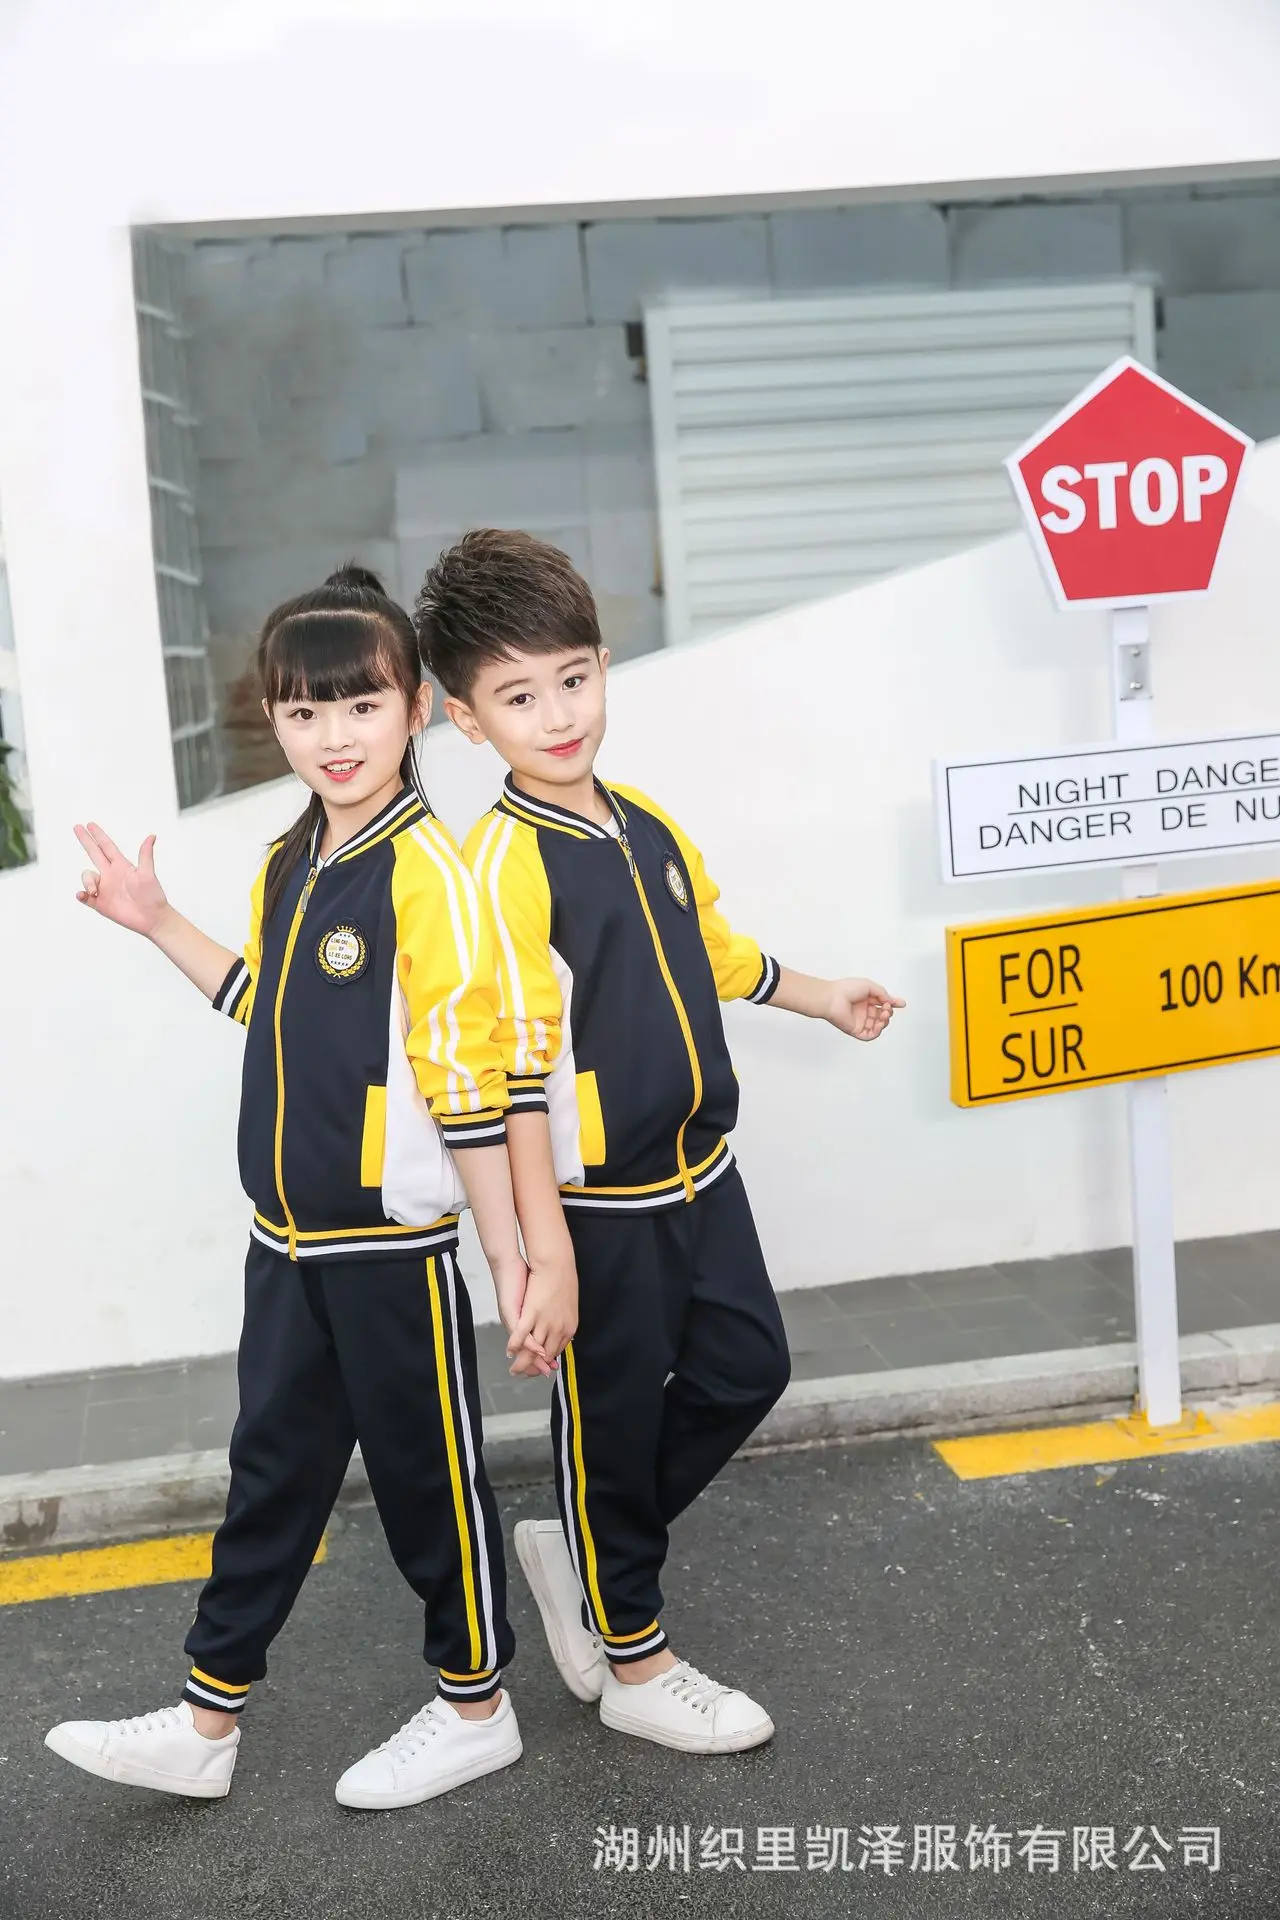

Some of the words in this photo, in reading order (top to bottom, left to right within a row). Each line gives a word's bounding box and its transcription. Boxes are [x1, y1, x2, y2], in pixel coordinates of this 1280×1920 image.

[1040, 454, 1229, 535] STOP
[1019, 773, 1129, 808] NIGHT
[1156, 757, 1280, 793] DANGE
[979, 811, 1132, 850] DANGER
[1161, 803, 1207, 831] DE
[1236, 795, 1280, 823] NU
[1000, 944, 1084, 1005] FOR
[1159, 960, 1222, 1012] 100
[1001, 1023, 1086, 1084] SUR
